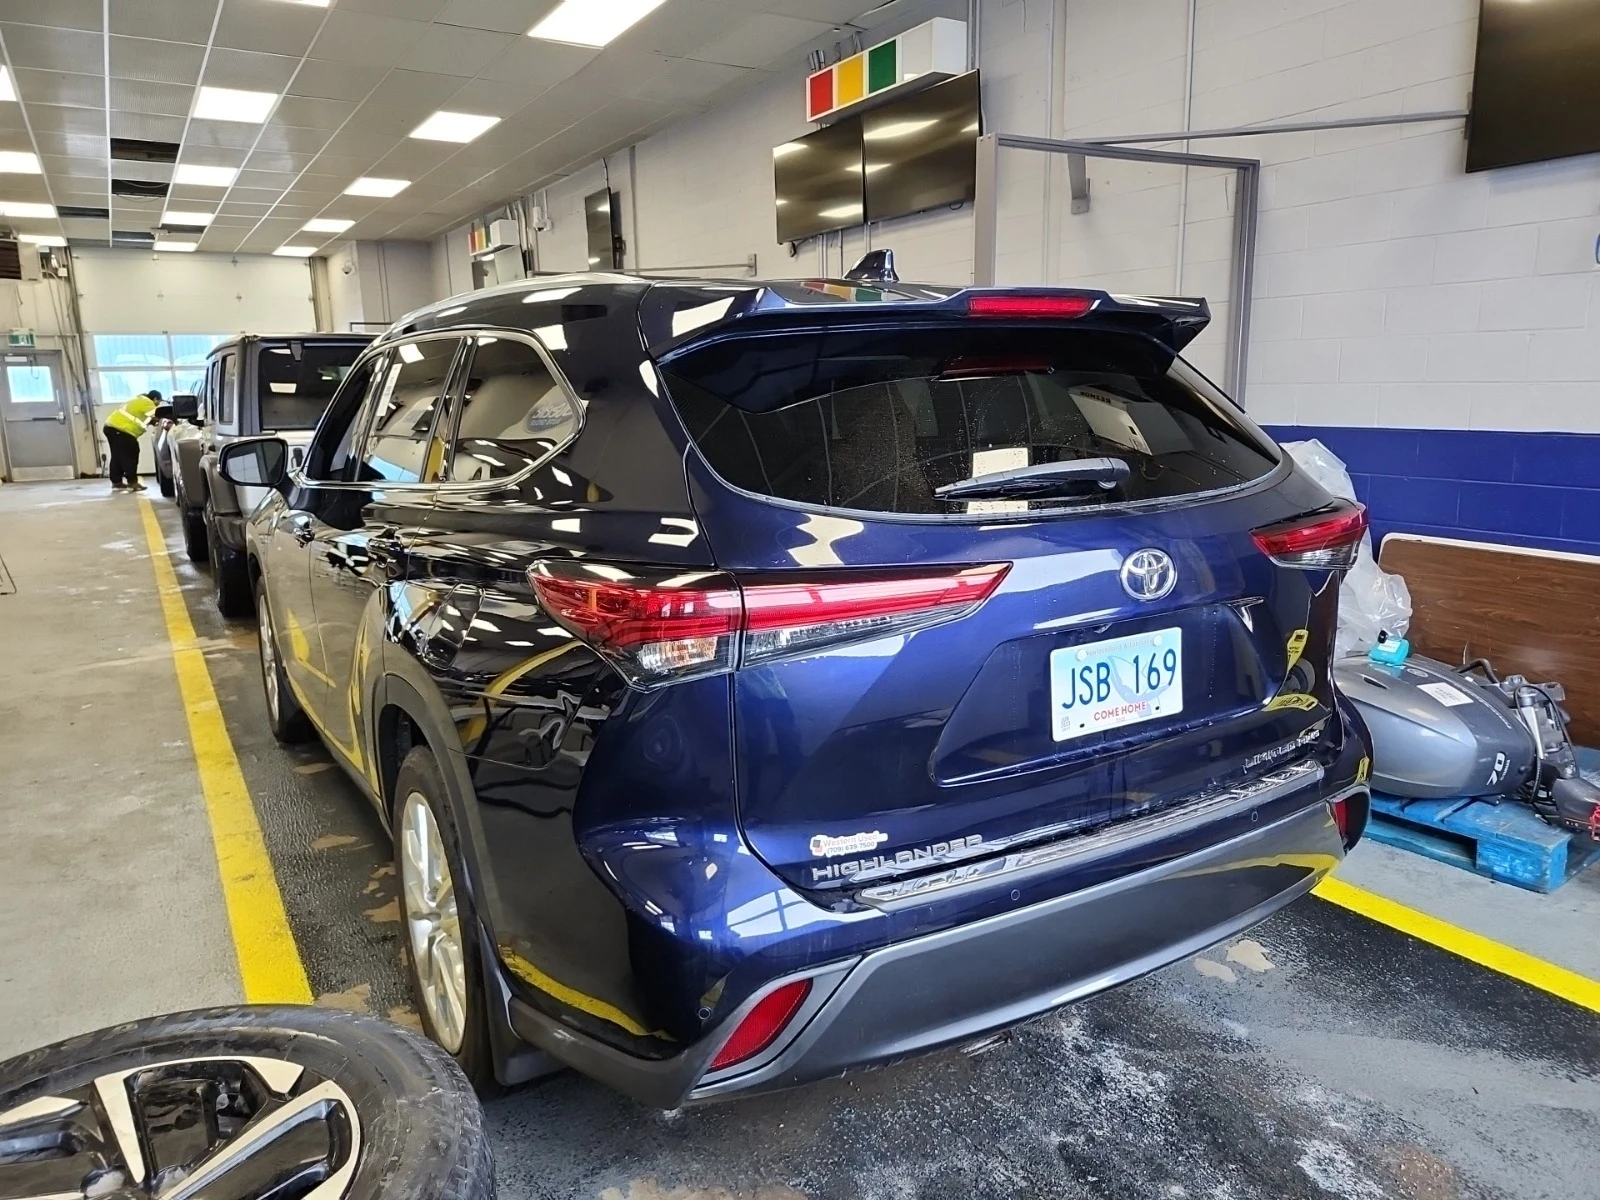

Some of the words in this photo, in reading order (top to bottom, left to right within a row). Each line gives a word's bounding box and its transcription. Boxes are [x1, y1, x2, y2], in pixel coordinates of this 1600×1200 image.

[1062, 662, 1111, 709] JSB
[1133, 648, 1177, 694] 169
[1093, 706, 1119, 721] COME
[1121, 701, 1146, 716] HOME
[1486, 752, 1506, 786] 70
[812, 834, 983, 881] HIGHLANDER
[823, 837, 856, 847] Western
[857, 834, 878, 842] Used
